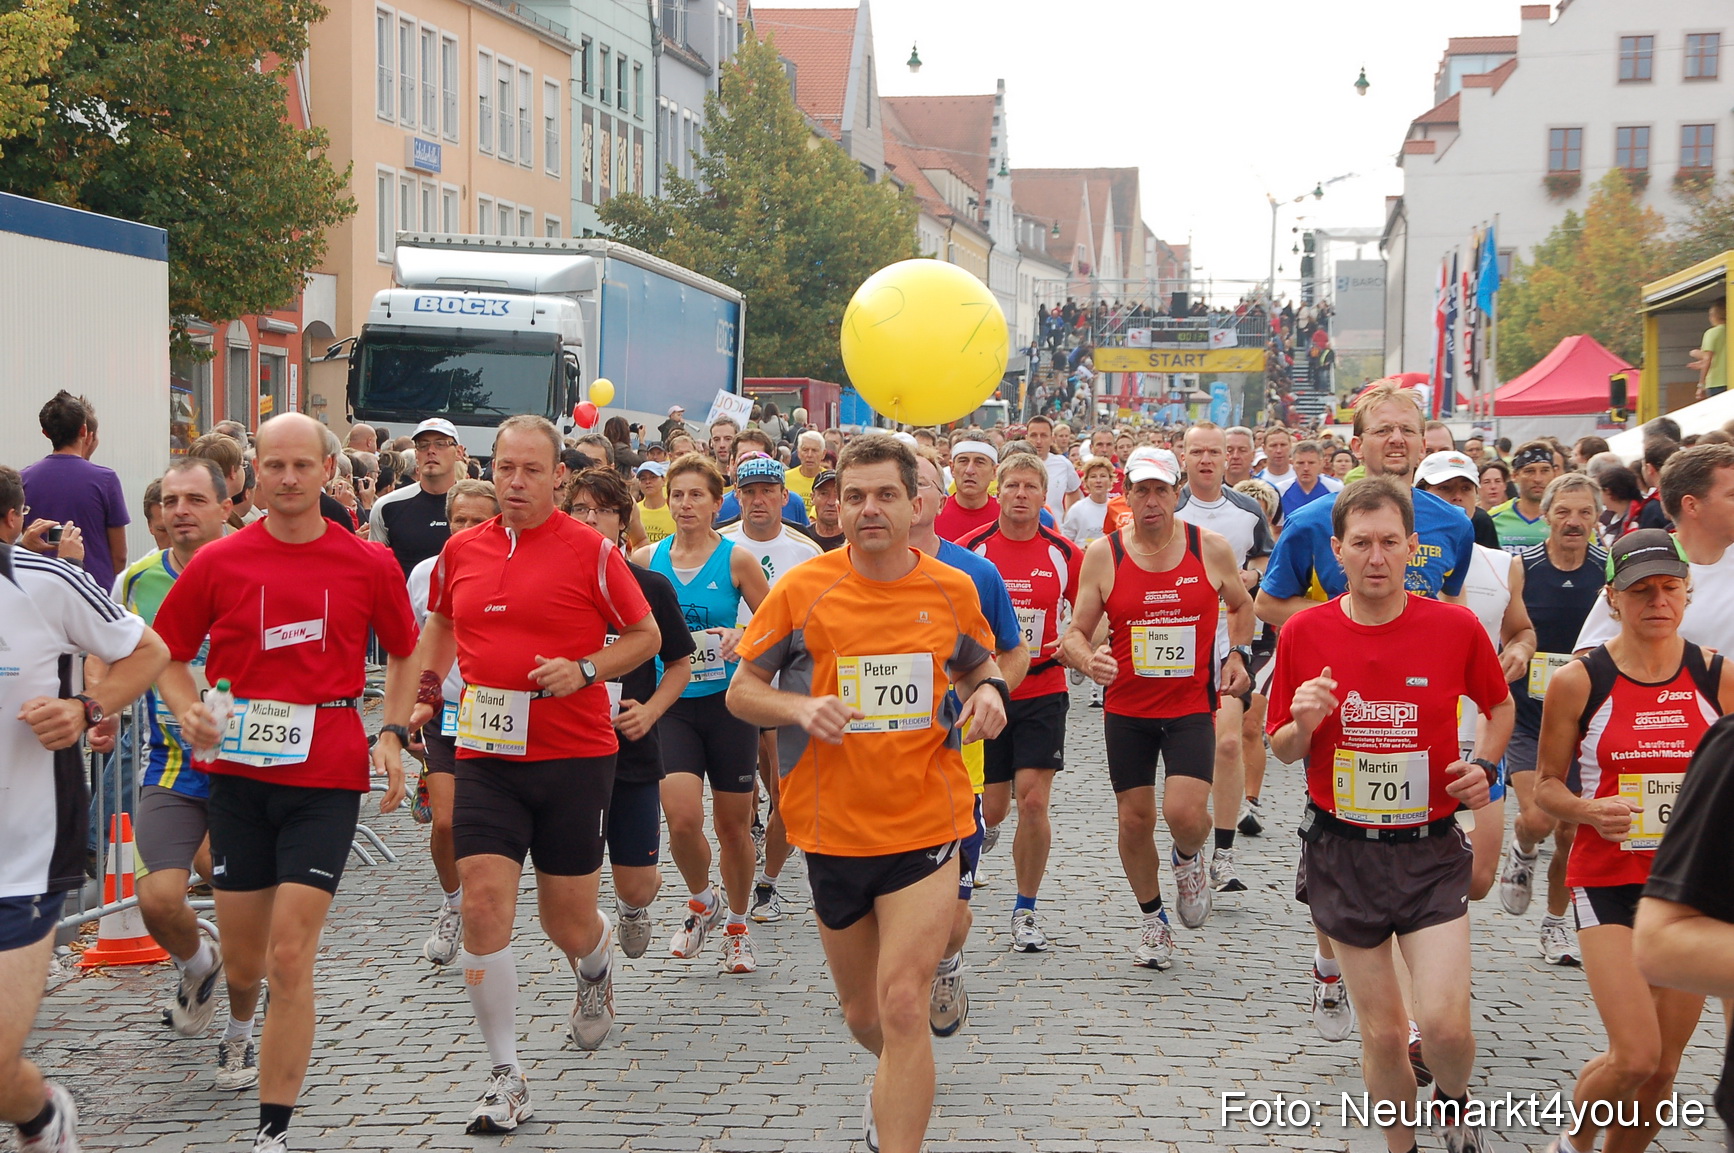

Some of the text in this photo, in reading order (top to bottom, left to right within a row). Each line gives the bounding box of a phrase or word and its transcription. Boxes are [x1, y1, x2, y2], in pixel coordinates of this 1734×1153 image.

[414, 296, 510, 316] BOCK
[1149, 353, 1207, 367] START
[1144, 609, 1181, 617] Lauftreff
[281, 628, 307, 640] DEHN
[1148, 631, 1169, 641] Hans
[1155, 646, 1185, 660] 752
[864, 662, 898, 676] Peter
[476, 690, 505, 706] Roland
[843, 686, 849, 696] B
[875, 684, 918, 706] 700
[1668, 691, 1693, 700] asics
[251, 703, 290, 718] Michael
[1361, 704, 1418, 727] Helpi
[480, 712, 513, 732] 143
[248, 723, 301, 744] 2536
[1344, 728, 1417, 736] www.helpi.com
[1638, 740, 1685, 749] Lauftreff
[1359, 758, 1398, 773] Martin
[1337, 777, 1343, 787] B
[1368, 781, 1410, 801] 701
